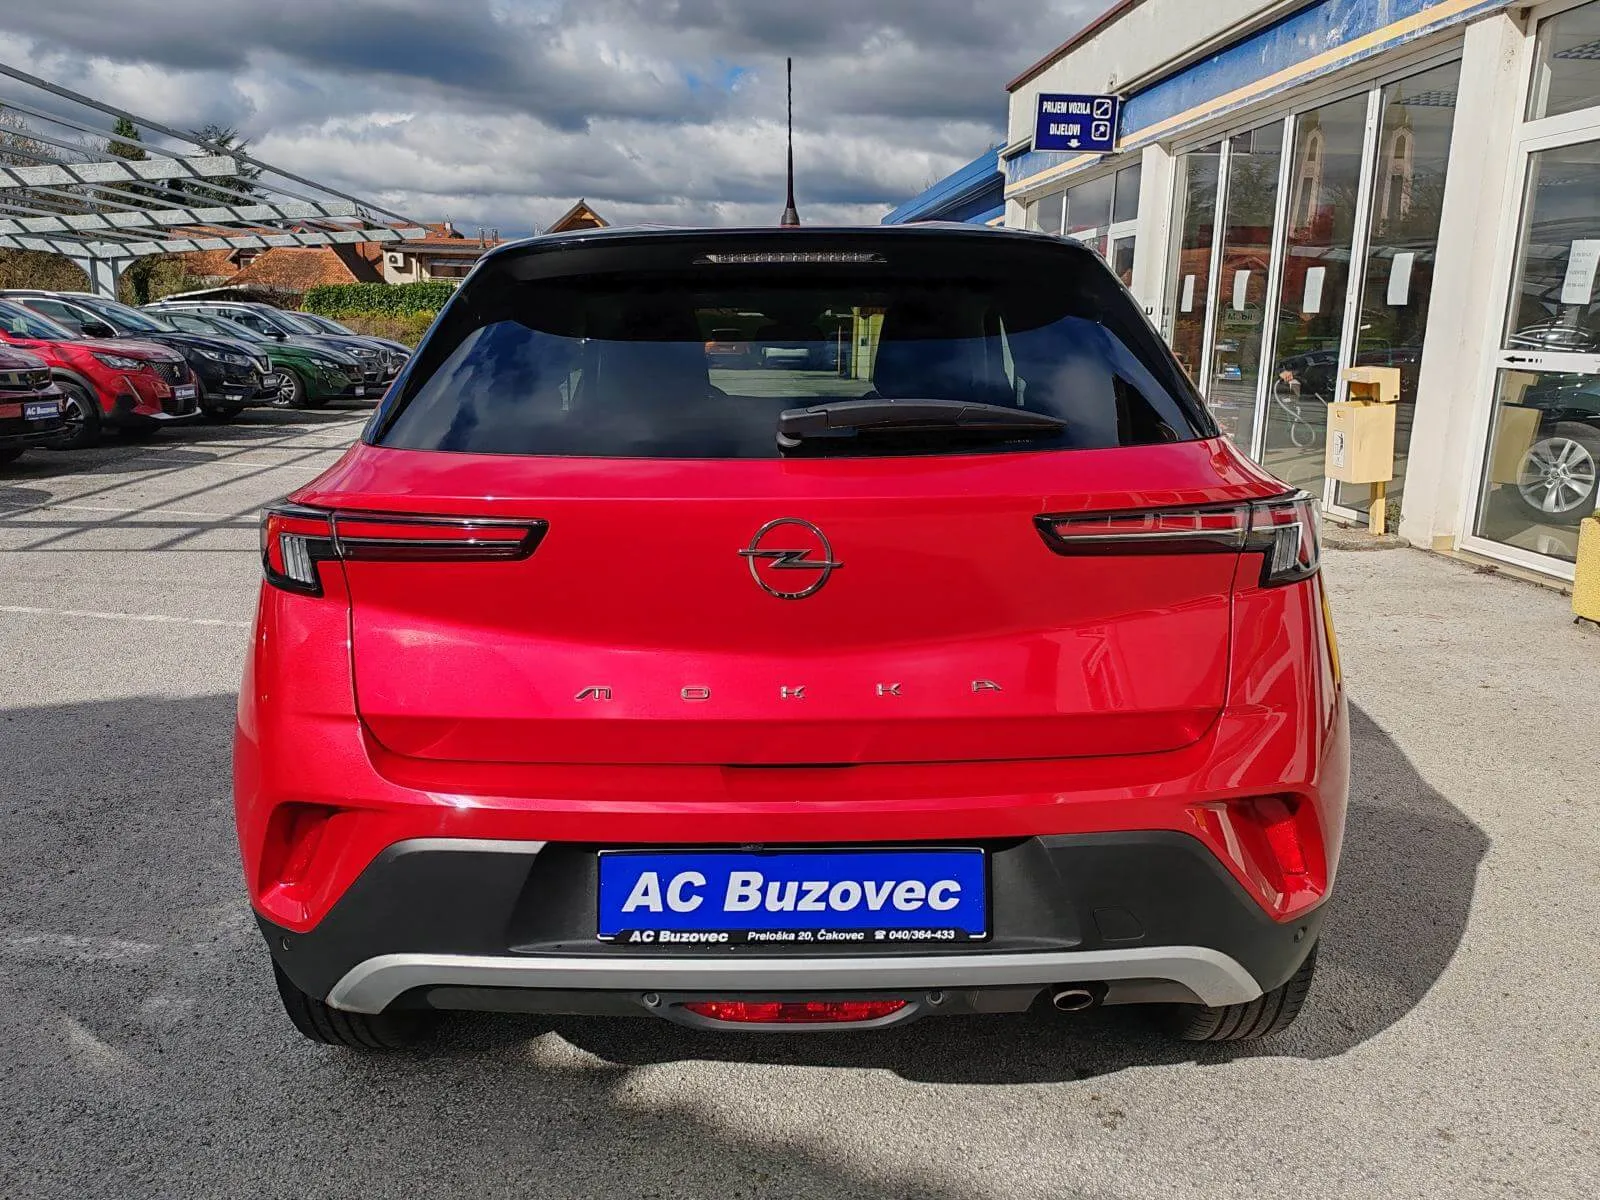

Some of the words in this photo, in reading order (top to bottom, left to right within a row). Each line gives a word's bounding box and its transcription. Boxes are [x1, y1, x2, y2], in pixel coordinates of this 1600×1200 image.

[1042, 101, 1067, 113] PRIJEM
[1068, 102, 1091, 114] VOZILA
[1049, 123, 1081, 135] DIJELOVI
[575, 678, 1003, 701] MOKKA
[621, 871, 707, 913] AC
[723, 871, 962, 912] Buzovec
[629, 930, 655, 942] AC
[658, 931, 729, 943] Buzovec
[747, 931, 795, 942] Preloška
[817, 928, 865, 941] Čakovec
[888, 929, 955, 940] 040/364-433
